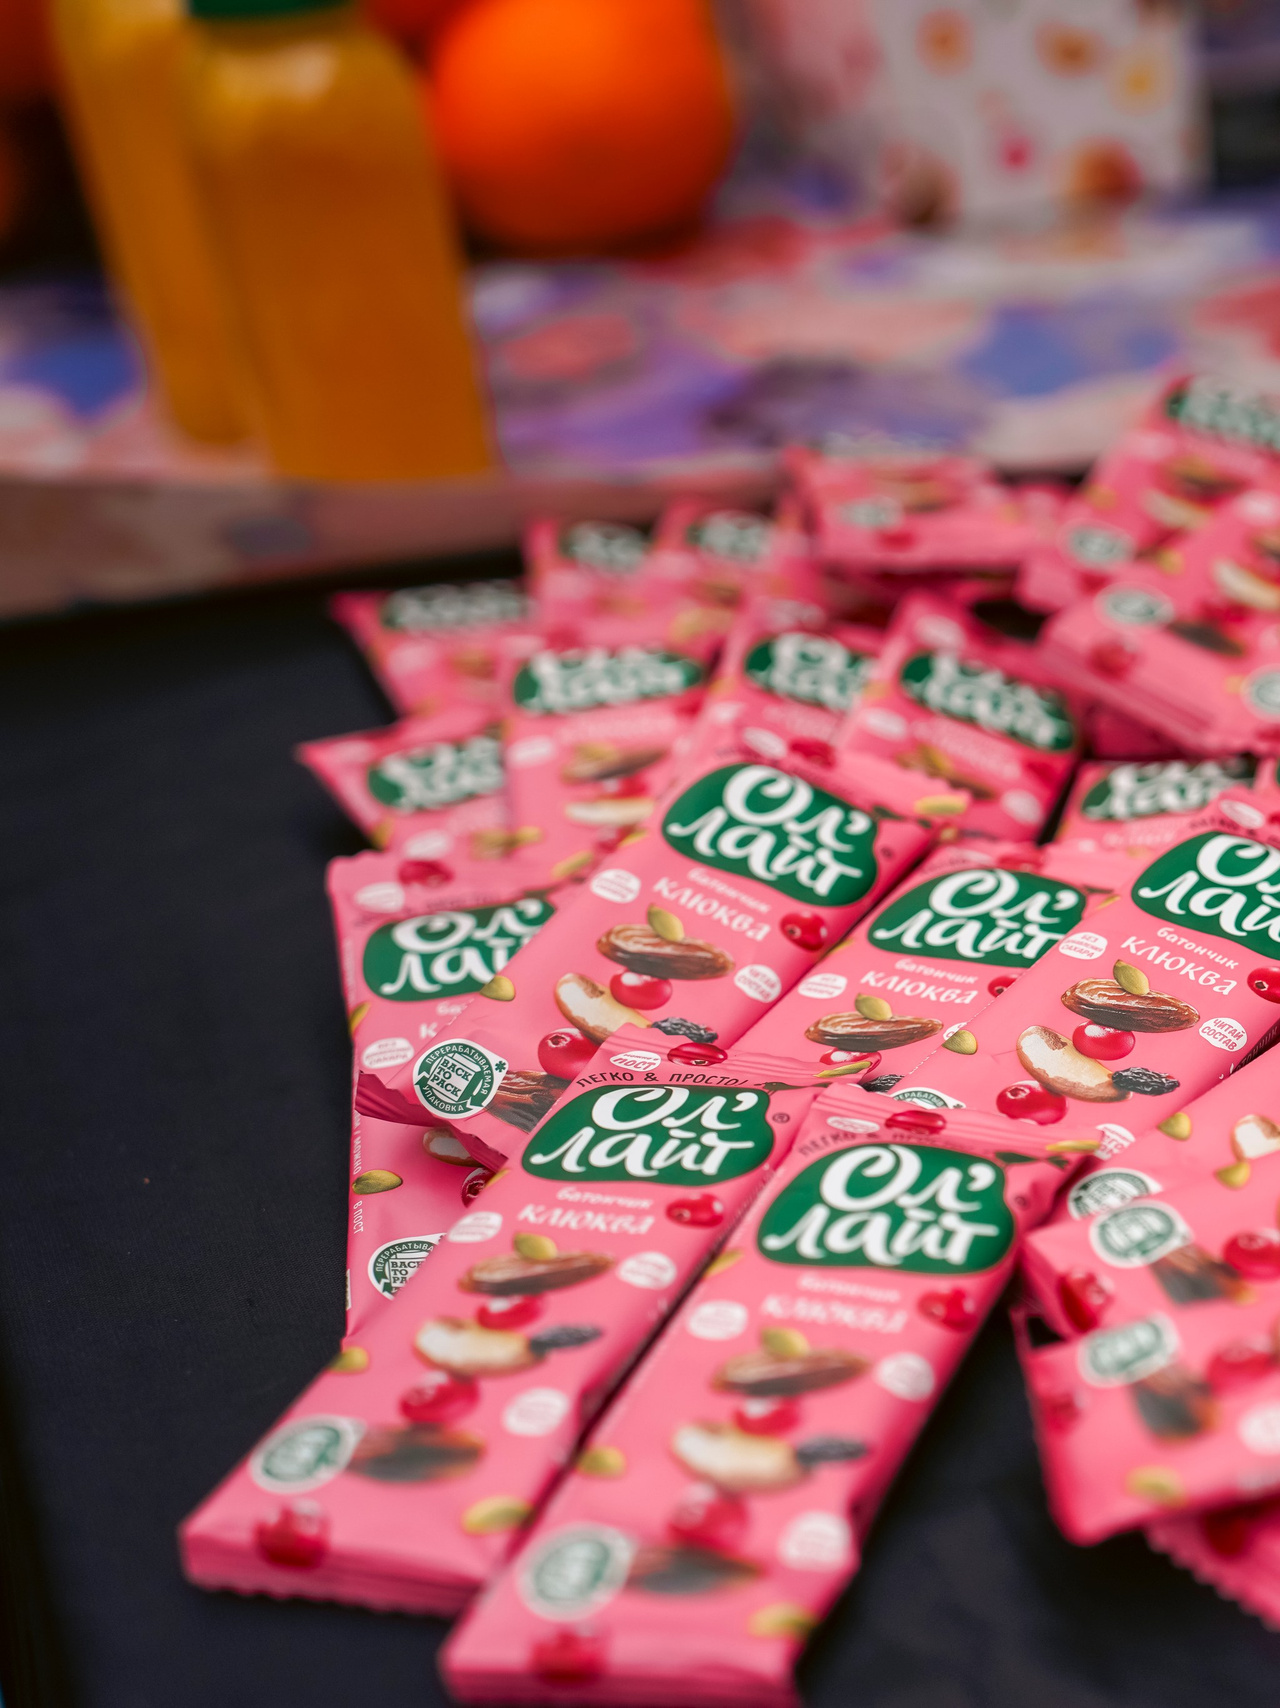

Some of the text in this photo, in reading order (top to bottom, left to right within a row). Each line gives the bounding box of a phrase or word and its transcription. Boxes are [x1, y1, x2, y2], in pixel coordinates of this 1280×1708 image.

[722, 765, 873, 852] Ол'
[666, 806, 863, 896] лайт
[928, 869, 1079, 924] Ол'
[391, 898, 543, 954] Ол'
[872, 908, 1066, 959] лайт
[1080, 934, 1099, 943] БЕЗ
[1060, 944, 1095, 958] САХАРА
[1157, 927, 1240, 970] батончик
[893, 958, 979, 985] батончик
[1200, 1026, 1238, 1051] СОСТАВ
[1212, 1018, 1246, 1041] ЧИТАЙ
[425, 1045, 492, 1095] ПЕРЕРАБАТЫВАЕМАЯ
[436, 1066, 452, 1080] TO
[440, 1058, 472, 1081] BACK
[613, 1057, 657, 1071] ПОСТ
[430, 1075, 462, 1097] PACK
[576, 1072, 749, 1088] ЛЕГКО & ПРОСТО!
[423, 1085, 464, 1112] УПАКОВКА
[591, 1086, 758, 1130] Ол'
[353, 1136, 363, 1175] МОЖНО
[529, 1126, 755, 1177] лайт
[820, 1145, 996, 1212] Ол'
[353, 1210, 364, 1234] ПОСТ
[762, 1203, 1000, 1265] лайт
[375, 1242, 434, 1272] ПЕРЕРАБАТЫВА
